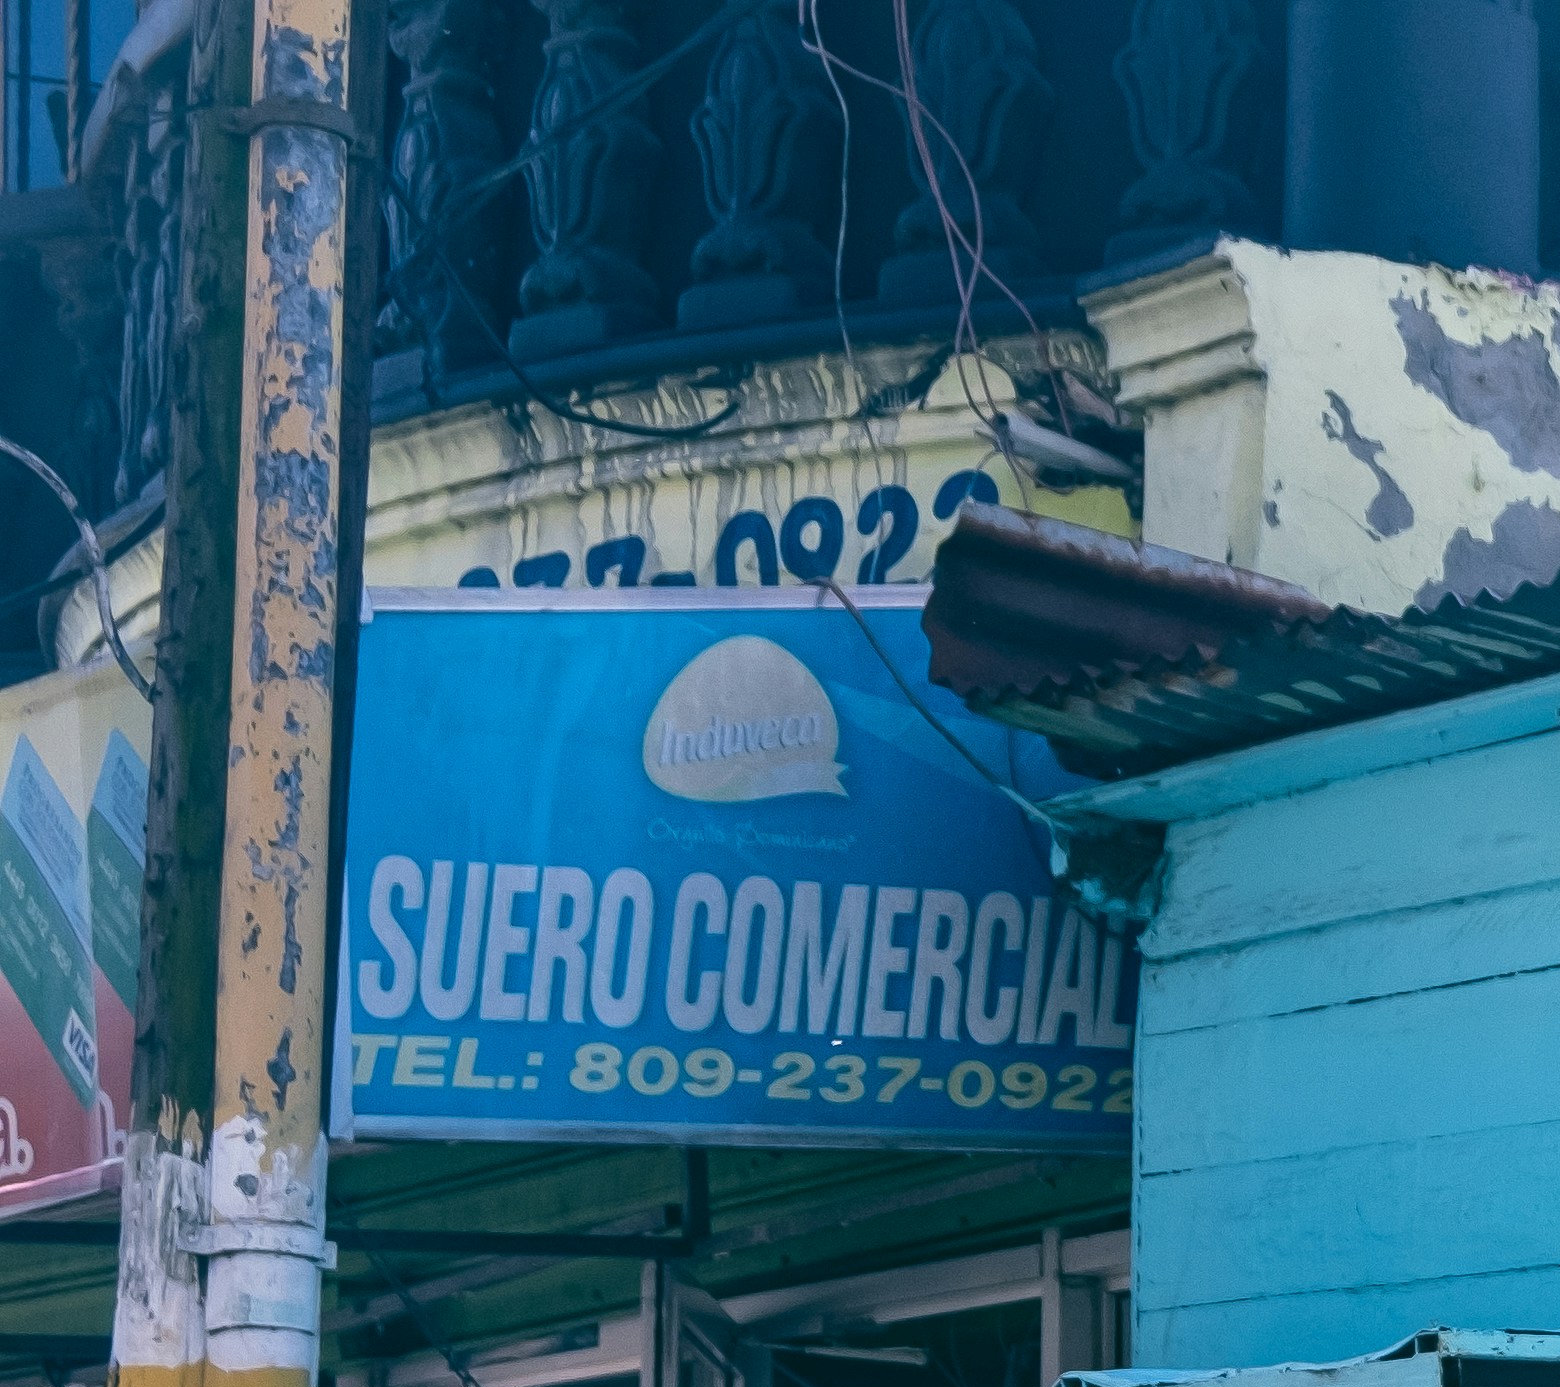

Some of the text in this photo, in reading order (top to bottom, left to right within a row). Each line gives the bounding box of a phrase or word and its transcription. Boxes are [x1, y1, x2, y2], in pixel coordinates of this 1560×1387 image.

[657, 713, 824, 769] Induveca
[358, 854, 1133, 1049] SUERO COMERCIAL
[352, 1033, 1133, 1114] TEL.: 809-237-0922
